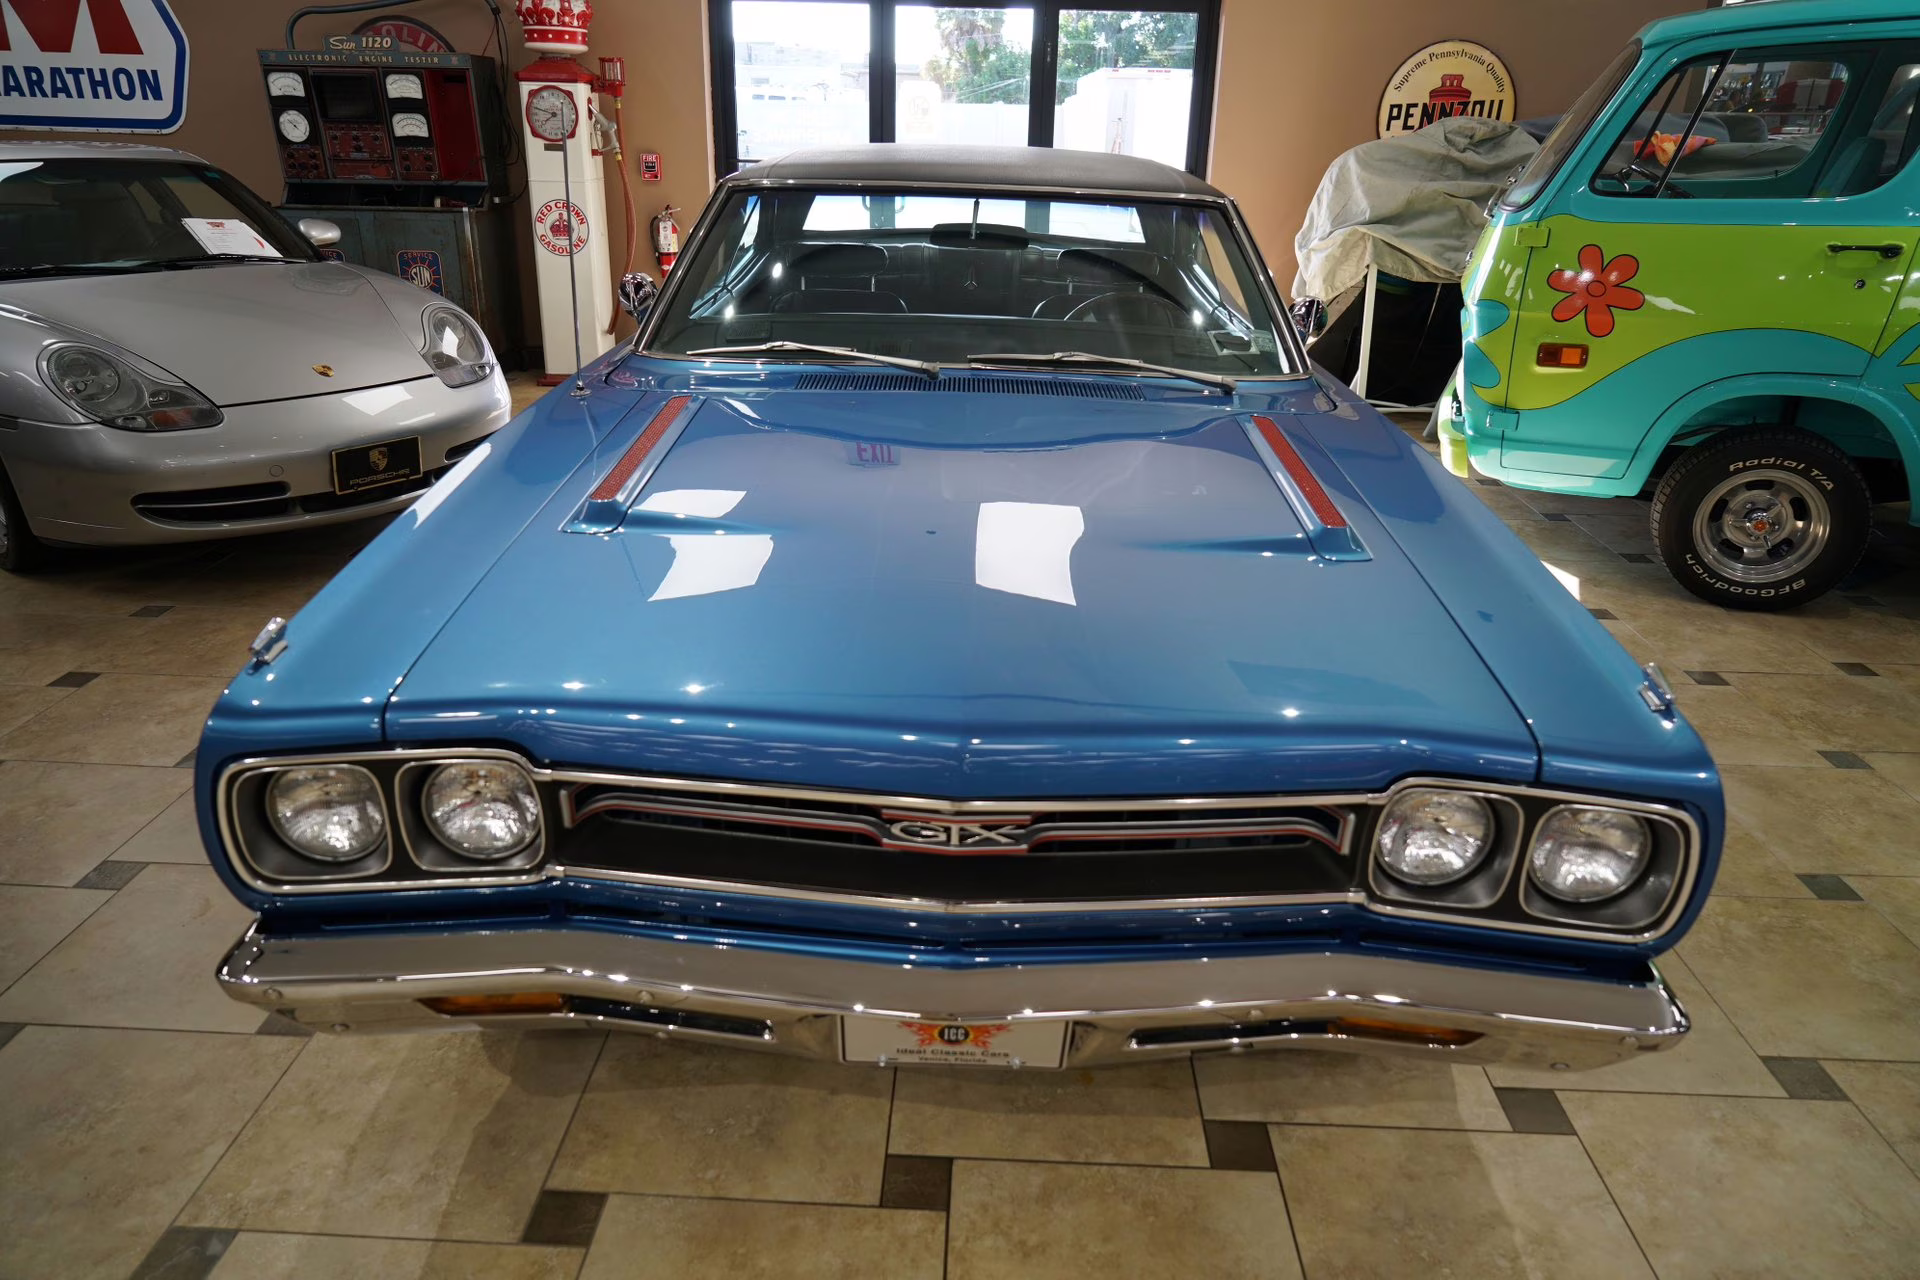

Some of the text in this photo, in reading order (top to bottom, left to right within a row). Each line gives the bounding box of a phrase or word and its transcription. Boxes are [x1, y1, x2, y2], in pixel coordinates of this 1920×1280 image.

[329, 36, 392, 49] Sun 1120
[288, 53, 440, 64] ELECTRONIC ENGINE TESTER
[1394, 48, 1506, 94] Supreme Pennsylvania Quality
[0, 65, 163, 101] ARATHON
[642, 154, 657, 162] FIRE
[537, 204, 553, 225] RED
[540, 234, 586, 255] GASOLNE
[403, 251, 433, 260] SERVICE
[410, 265, 432, 287] SUN
[349, 468, 411, 486] PORSCHE
[1729, 456, 1835, 491] Radial T/A
[1685, 552, 1807, 597] BFGoodrich
[889, 820, 1017, 846] GTX
[943, 1027, 966, 1041] ICC
[896, 1047, 1010, 1058] Ideal Classic Cars
[954, 1056, 988, 1064] Florida
